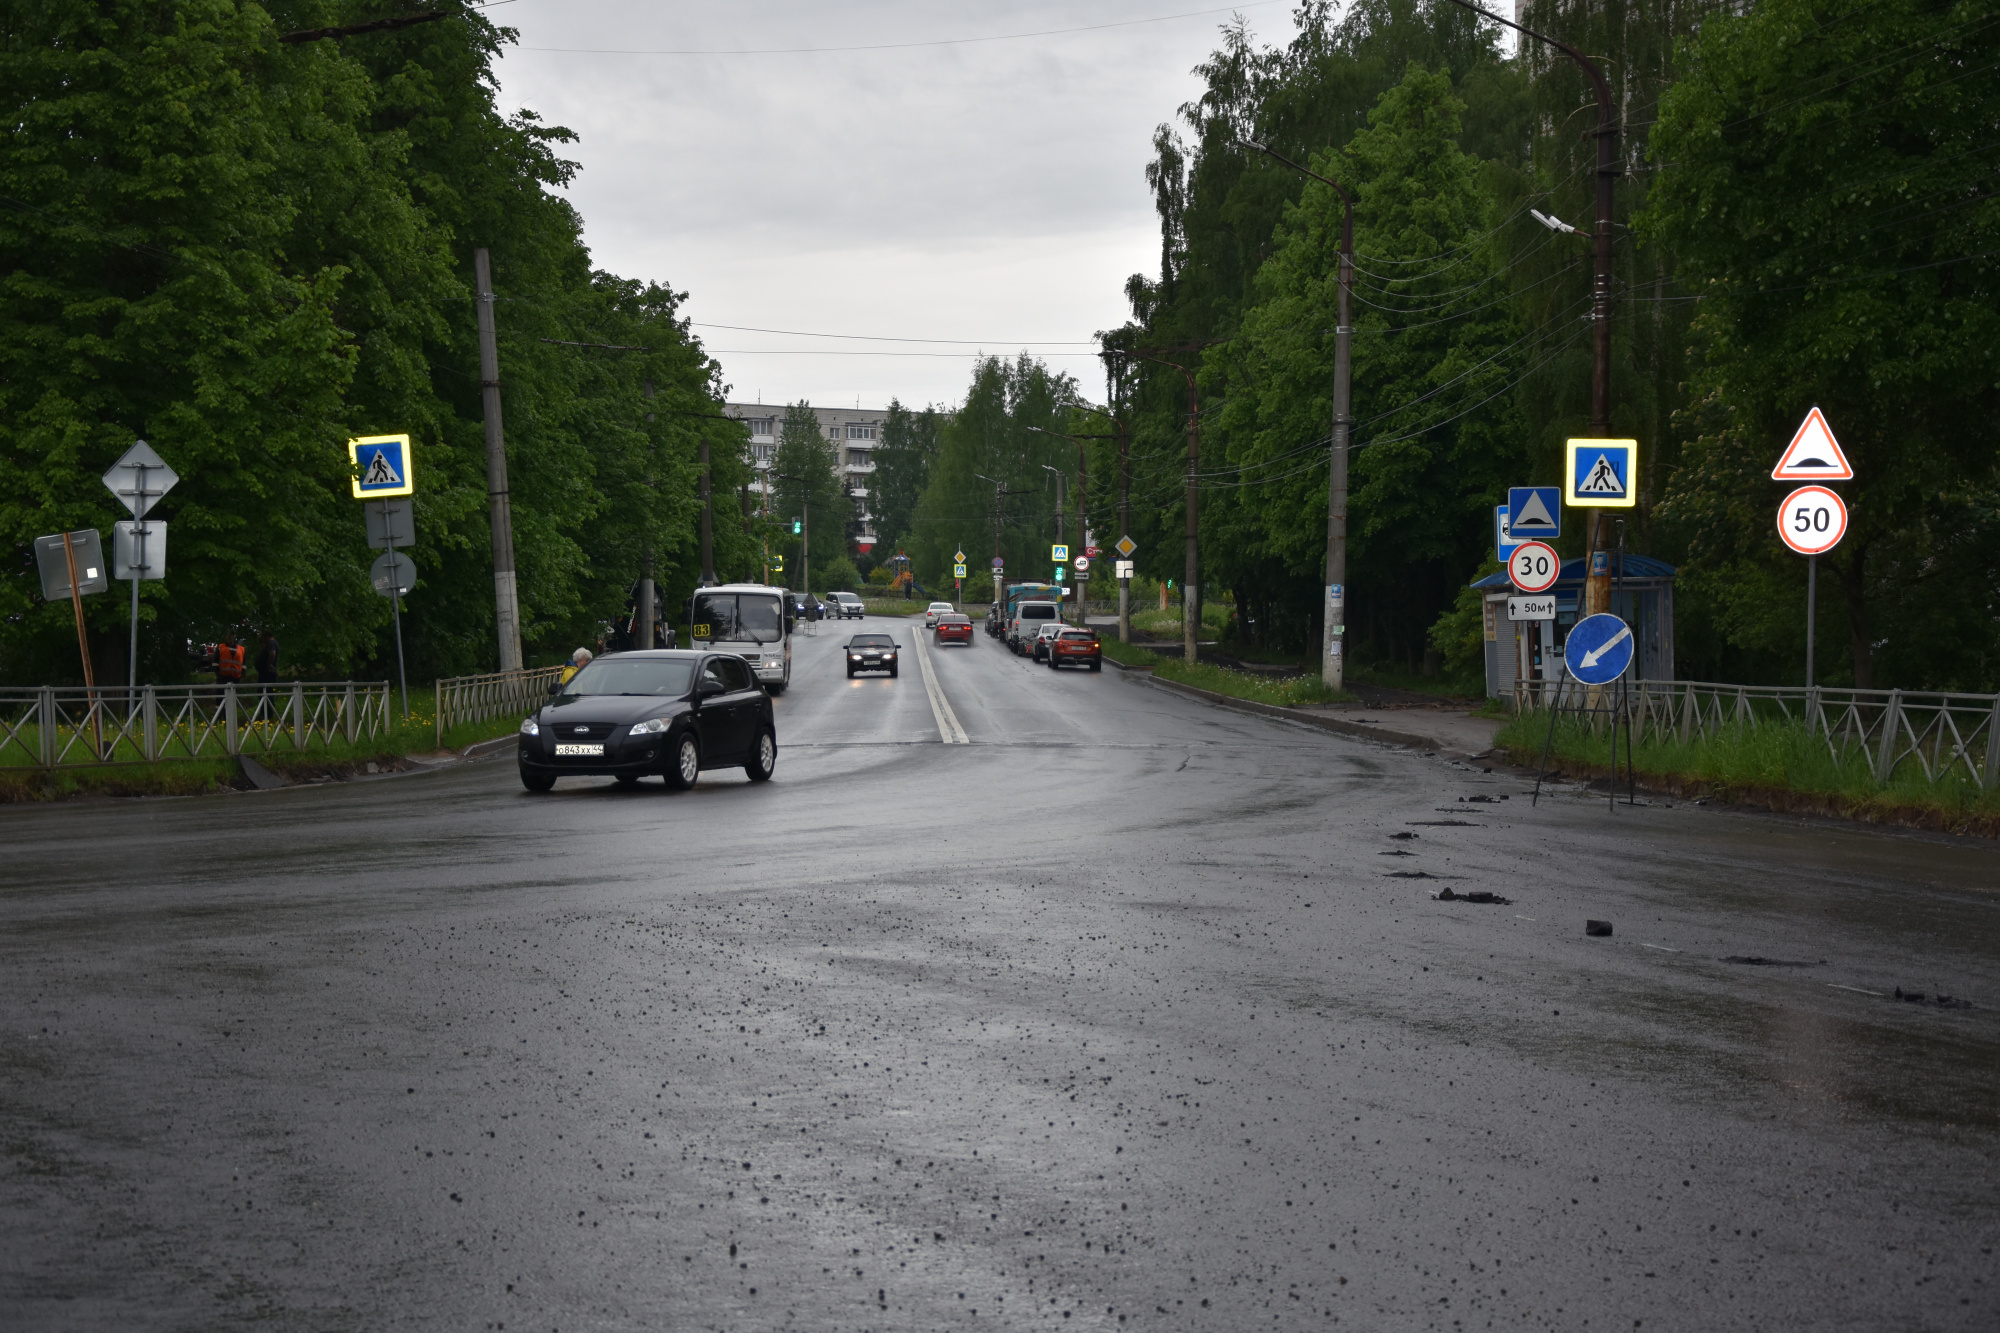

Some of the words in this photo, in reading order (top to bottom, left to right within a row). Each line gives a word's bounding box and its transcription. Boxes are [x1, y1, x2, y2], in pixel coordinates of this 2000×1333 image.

[1794, 507, 1830, 533] 50
[1520, 556, 1549, 576] 30
[694, 625, 710, 636] 83
